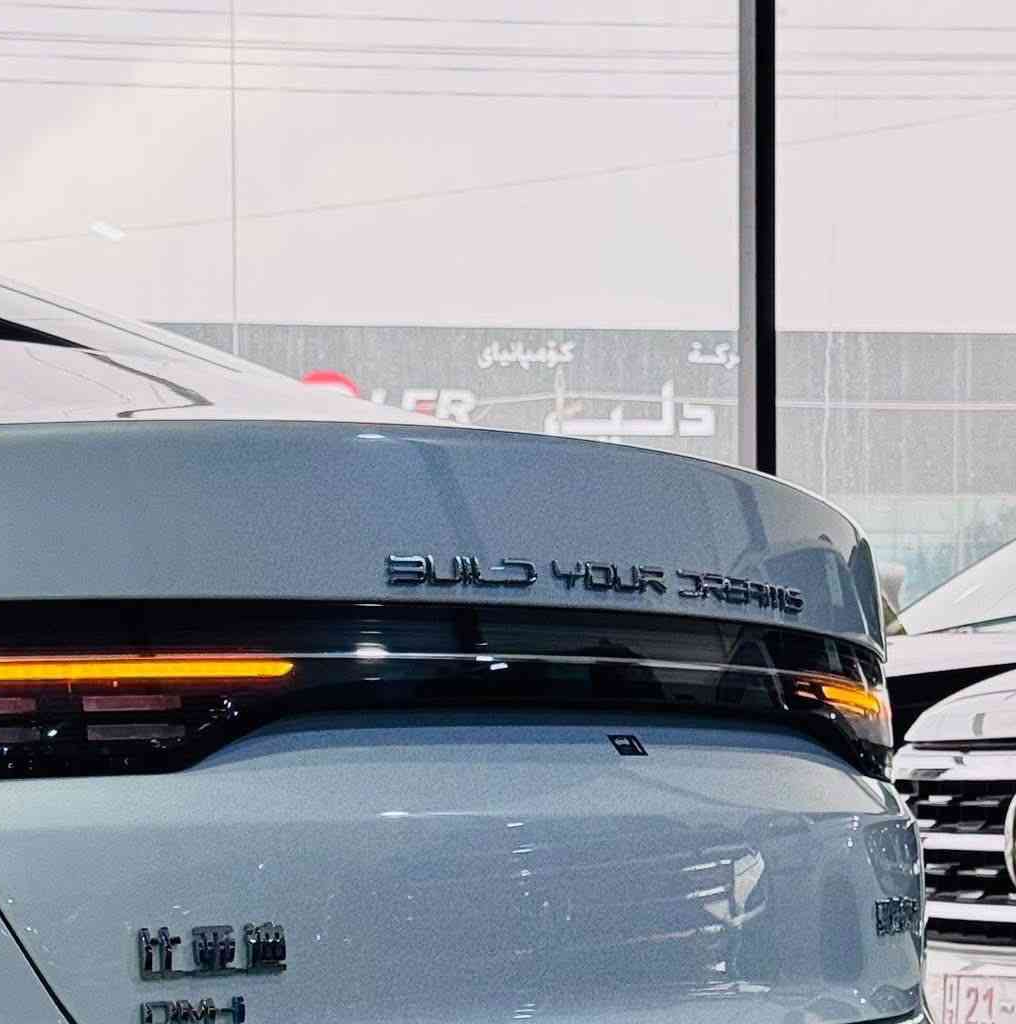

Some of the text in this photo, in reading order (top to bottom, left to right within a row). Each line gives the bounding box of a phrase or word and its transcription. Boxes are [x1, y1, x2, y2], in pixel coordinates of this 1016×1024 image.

[387, 553, 805, 614] BUILD YOUR DREAMS
